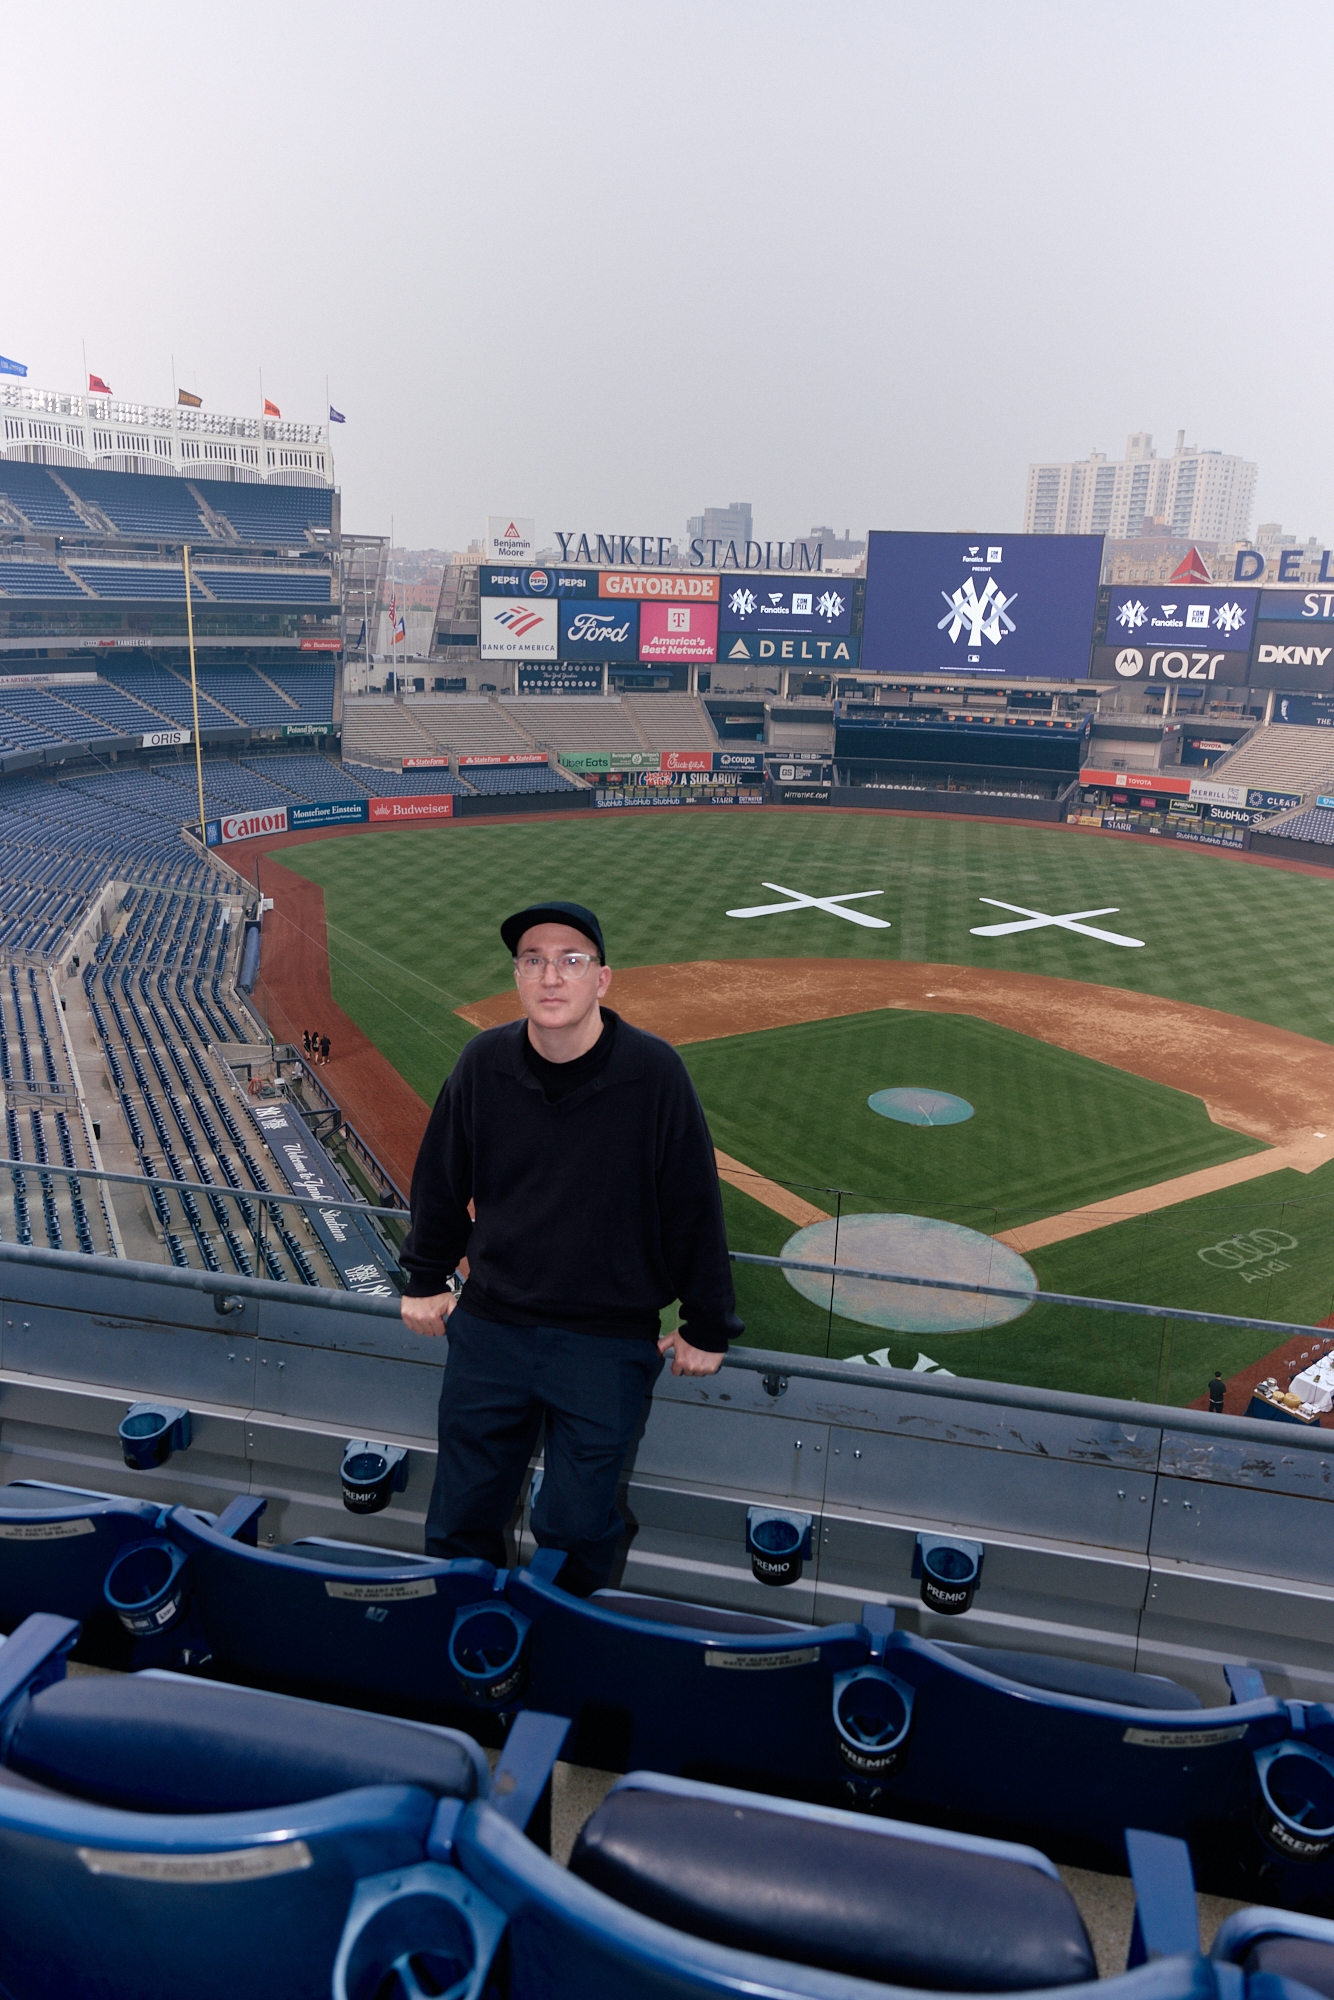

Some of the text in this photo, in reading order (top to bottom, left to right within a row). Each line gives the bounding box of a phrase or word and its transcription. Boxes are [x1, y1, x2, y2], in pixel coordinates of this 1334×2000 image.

[494, 539, 530, 549] Benjamin
[499, 548, 524, 557] Moore
[554, 532, 824, 572] YANKEE STADIUM
[491, 575, 519, 585] PEPSI
[558, 578, 587, 587] PEPSI
[606, 576, 714, 596] GATORADE
[760, 605, 790, 614] Fanatics
[1301, 592, 1334, 617] ST
[567, 613, 631, 642] Ford
[1151, 618, 1184, 627] Fanatics
[650, 636, 706, 646] America's
[641, 645, 714, 655] Best Network
[759, 640, 851, 660] DELTA
[1258, 644, 1333, 666] DKNY
[1148, 651, 1225, 680] razr
[286, 724, 328, 735] Poland Spring
[151, 732, 181, 745] ORIS
[562, 759, 585, 768] Uber
[585, 758, 609, 767] Eats
[731, 756, 755, 765] coupa
[781, 768, 793, 776] GS
[680, 773, 743, 785] A SUB ABOVE
[1128, 778, 1152, 786] TOYOTA
[1191, 789, 1226, 799] MERRILL
[711, 796, 734, 804] STARR
[1267, 797, 1297, 808] CLEAR
[293, 804, 362, 819] Montefiore Einstein
[393, 804, 449, 815] Budweiser
[1210, 808, 1249, 822] StubHub
[223, 813, 285, 839] Canon
[1107, 821, 1132, 831] STARR
[1176, 831, 1199, 841] StubHub
[1200, 836, 1221, 845] StubHub
[1222, 839, 1243, 849] StubHub
[283, 1142, 308, 1172] Welcome
[299, 1171, 315, 1180] to
[319, 1207, 348, 1242] Stadium
[1239, 1258, 1292, 1284] Audi
[752, 1554, 790, 1573] PREMIO
[927, 1583, 967, 1601] PREMIO
[840, 1742, 897, 1767] PREMIO
